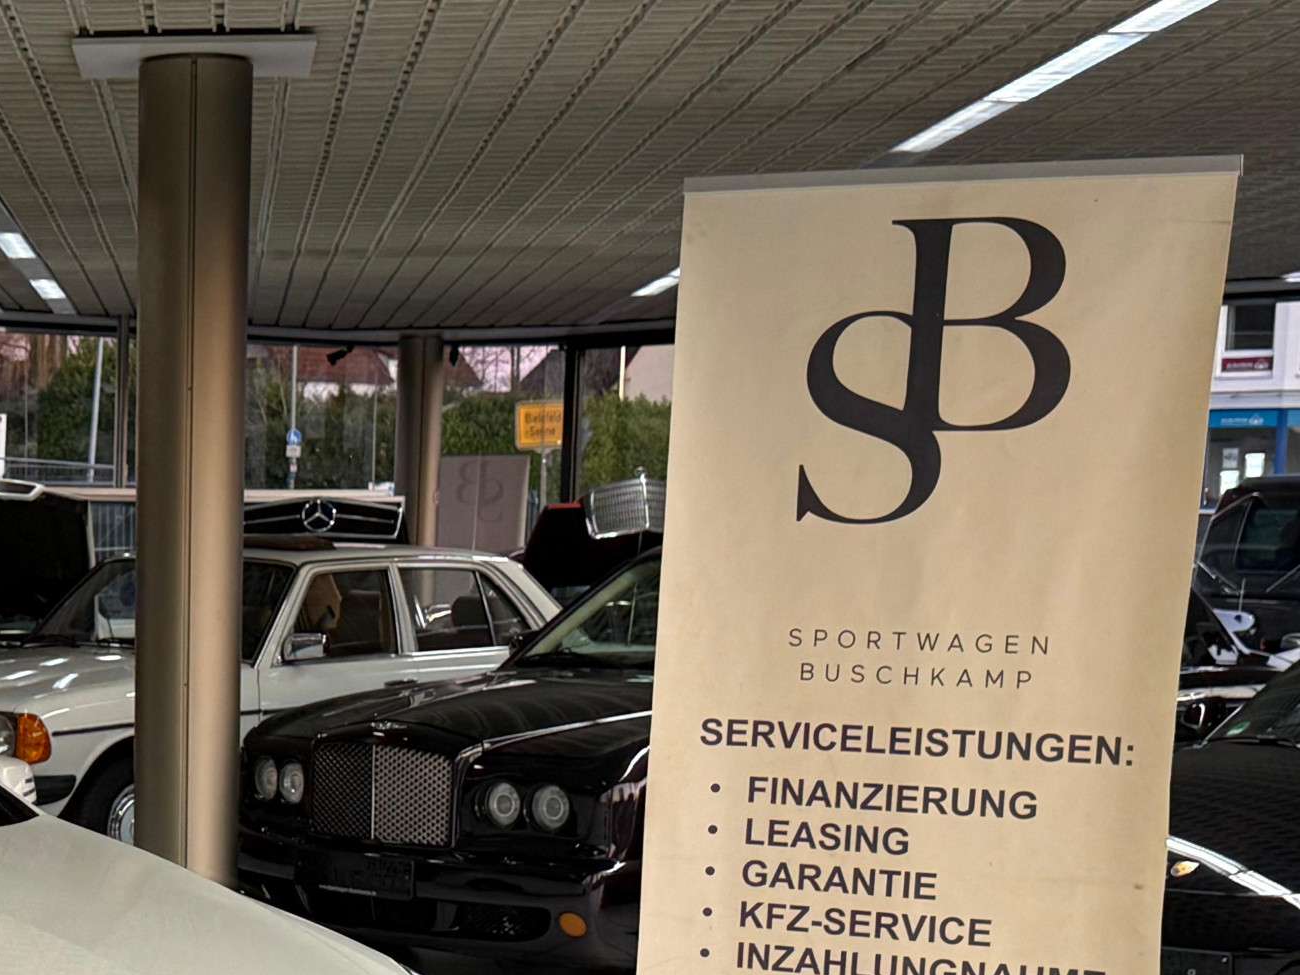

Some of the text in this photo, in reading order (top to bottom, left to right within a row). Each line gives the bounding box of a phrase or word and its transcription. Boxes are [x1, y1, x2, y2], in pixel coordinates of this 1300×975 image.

[788, 628, 1050, 655] SPORTWAGEN
[800, 662, 1033, 689] BUSCHKAMP
[700, 718, 1134, 767] SERVICELEISTUNGEN:
[747, 776, 1037, 819] FINANZIERUNG
[745, 818, 909, 856] LEASING
[742, 859, 937, 900] GARANTIE
[739, 900, 992, 947] KFZ-SERVICE
